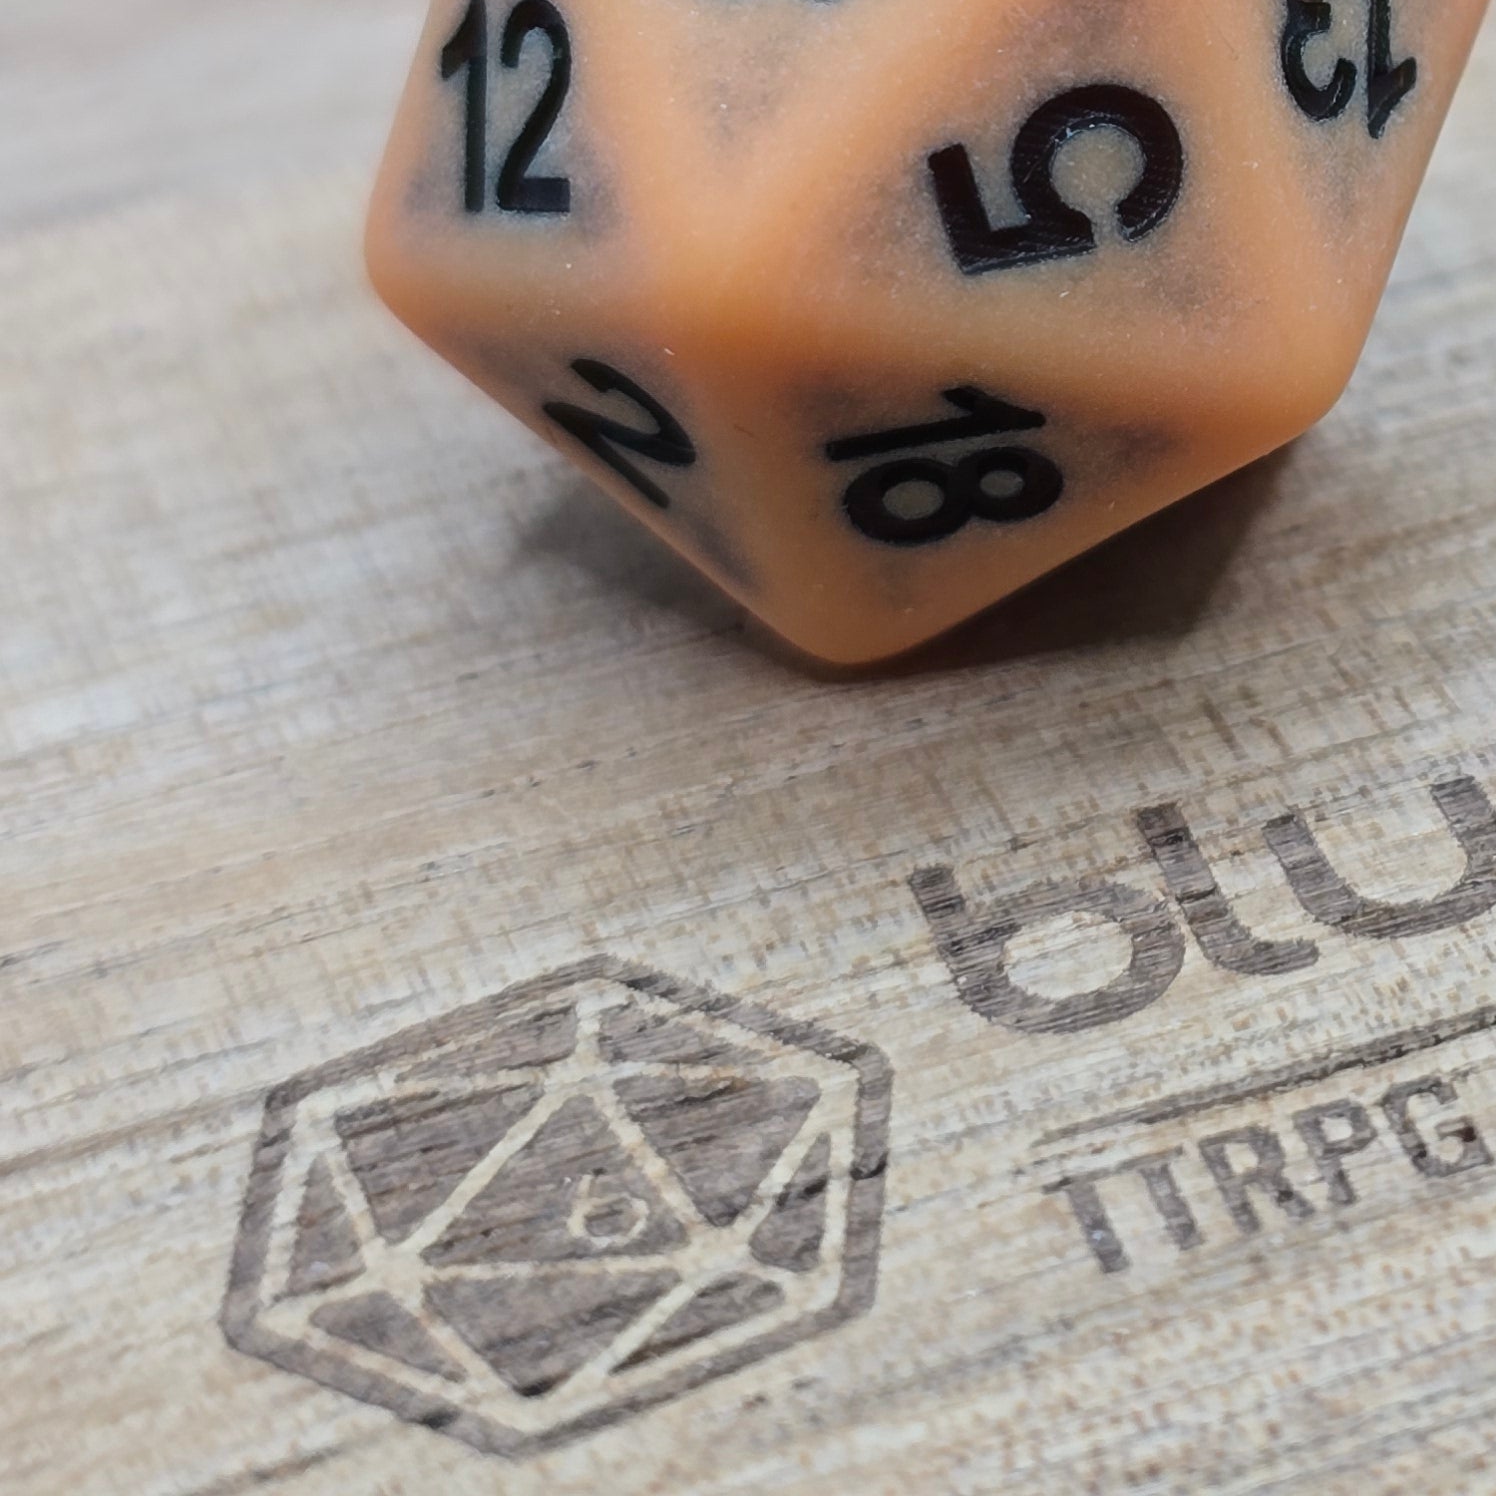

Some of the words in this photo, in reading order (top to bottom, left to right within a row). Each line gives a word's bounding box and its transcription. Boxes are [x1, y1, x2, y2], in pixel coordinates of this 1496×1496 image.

[926, 83, 1184, 276] 5
[542, 359, 697, 507] 2
[825, 384, 1064, 544] 18
[1046, 1082, 1490, 1273] TTRPG
